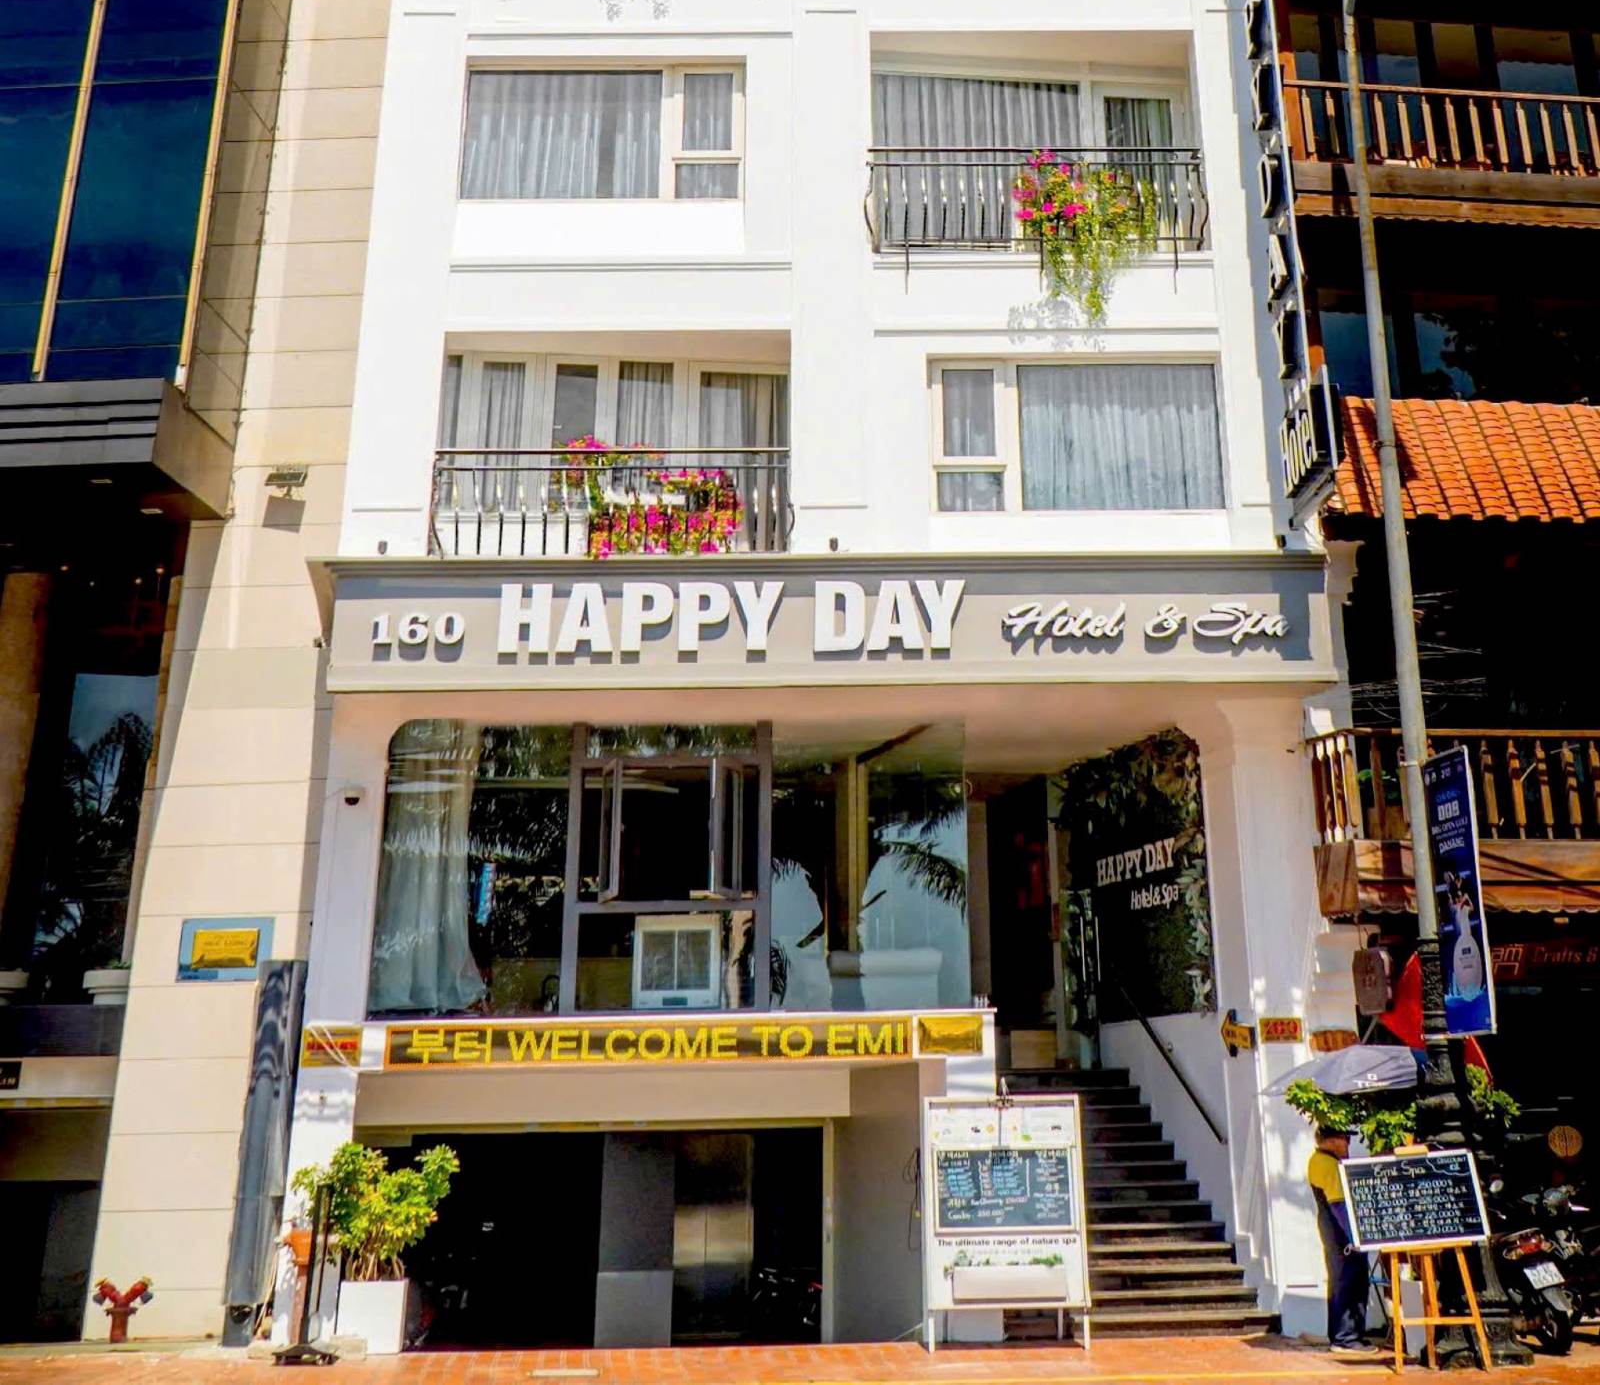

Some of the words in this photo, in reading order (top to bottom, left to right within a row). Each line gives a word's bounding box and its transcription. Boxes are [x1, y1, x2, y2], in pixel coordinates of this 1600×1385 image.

[1279, 409, 1317, 500] Hotel
[371, 611, 466, 646] 160
[498, 580, 785, 654] HAPPY
[813, 578, 967, 653] DAY
[1002, 600, 1126, 639] Hotel
[1144, 602, 1187, 639] &
[1192, 601, 1290, 644] Spa
[1096, 847, 1144, 886] HAPPY
[1144, 837, 1176, 873] DAY
[1131, 884, 1153, 910] Hotel
[1161, 883, 1179, 910] Spa
[406, 1028, 492, 1064] 부터
[507, 1026, 738, 1062] WELCOME
[751, 1025, 815, 1058] TO
[826, 1022, 905, 1056] EMI
[955, 1238, 990, 1246] ultimate
[992, 1239, 1017, 1247] range
[1032, 1237, 1059, 1245] nature
[1062, 1237, 1077, 1245] spa
